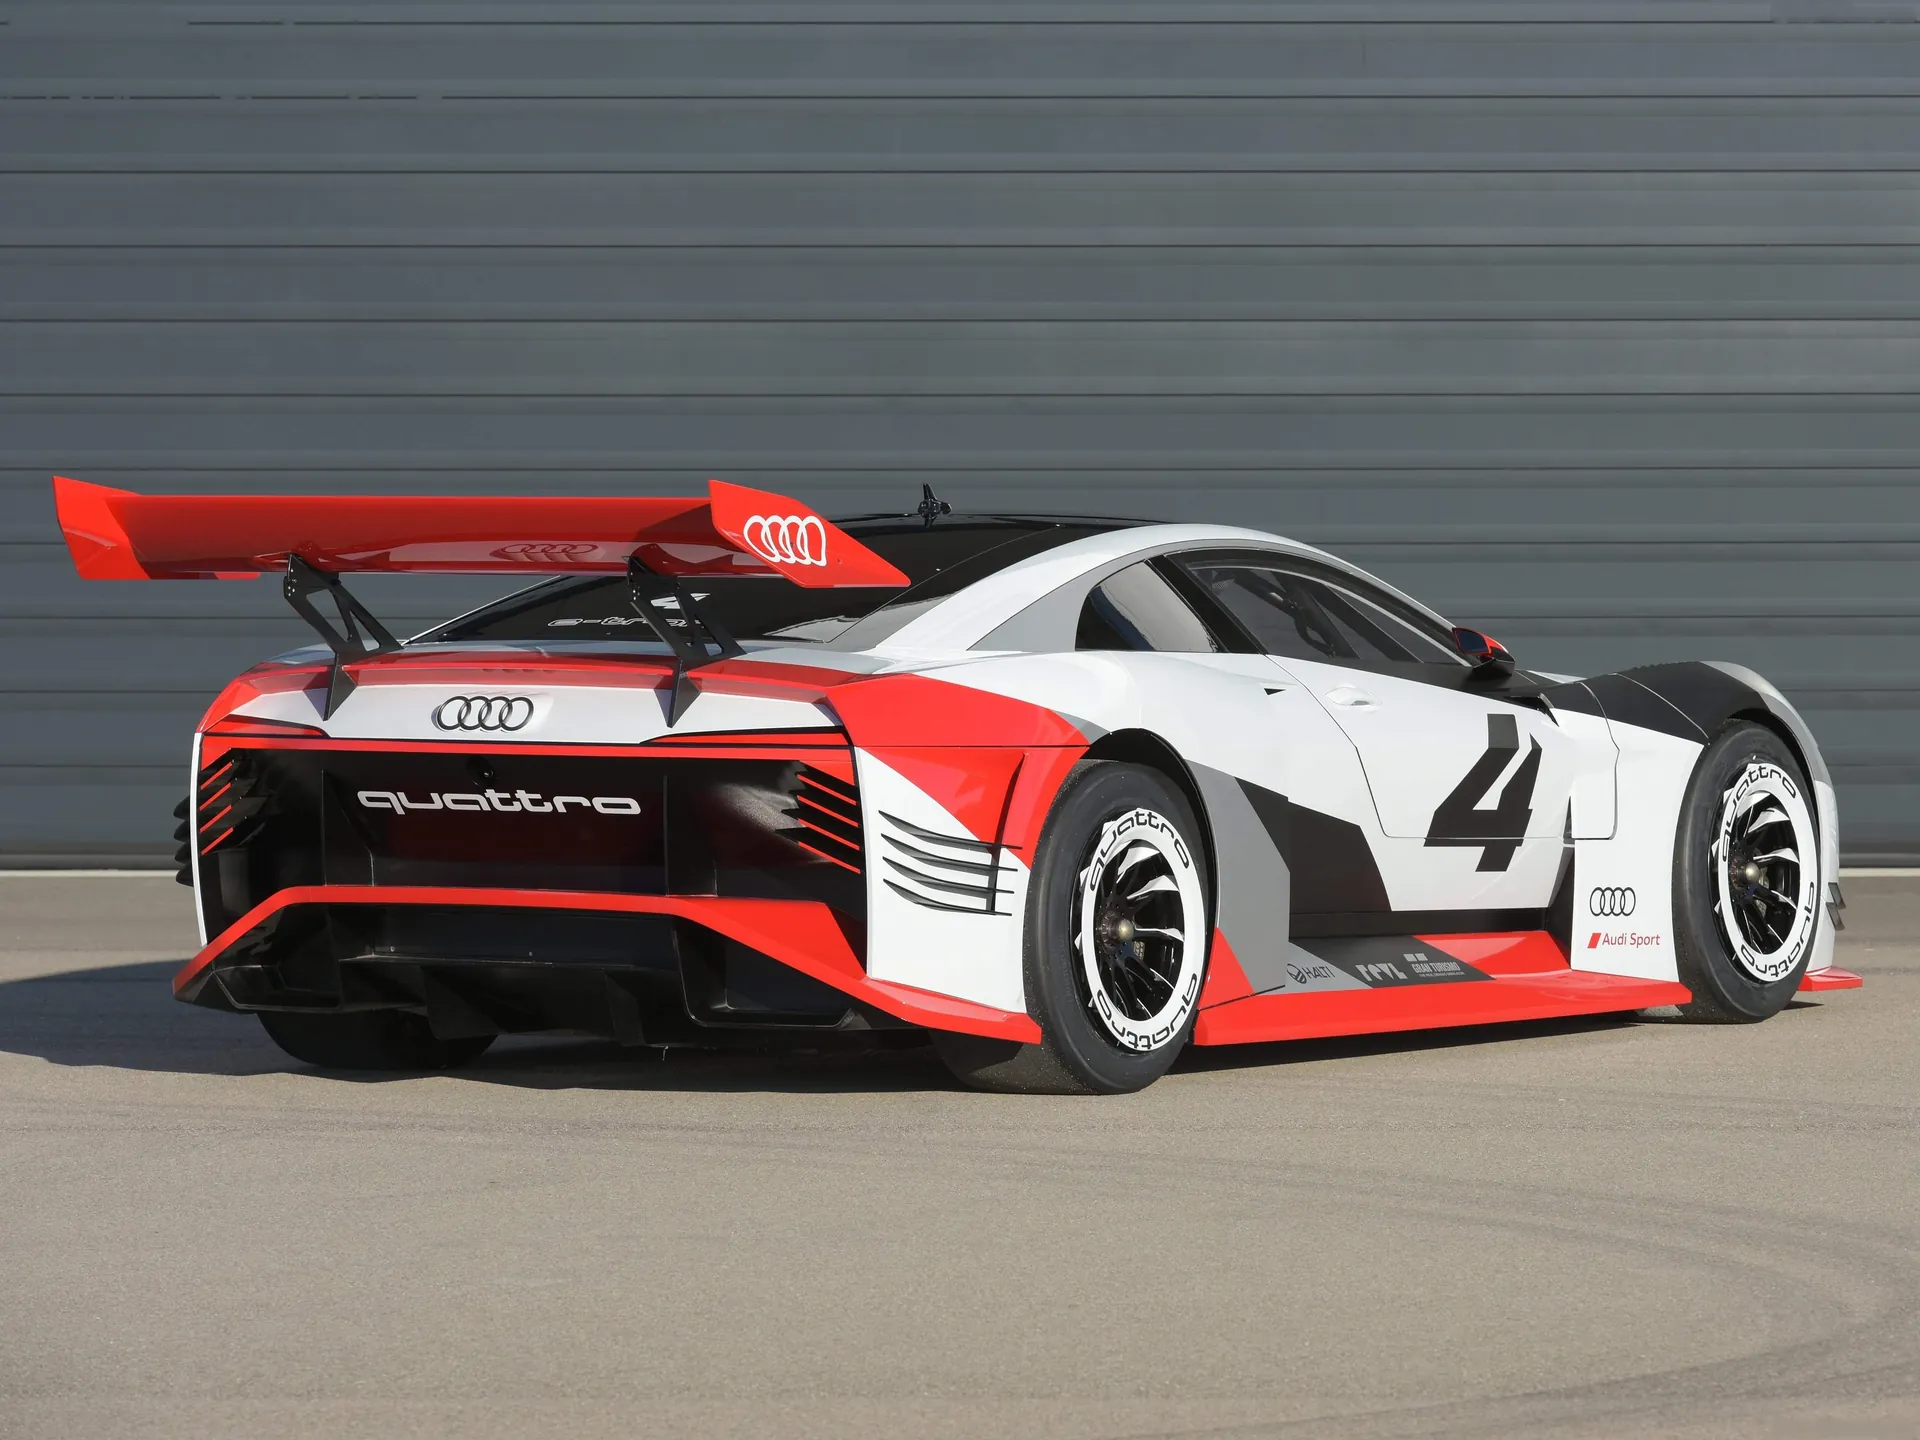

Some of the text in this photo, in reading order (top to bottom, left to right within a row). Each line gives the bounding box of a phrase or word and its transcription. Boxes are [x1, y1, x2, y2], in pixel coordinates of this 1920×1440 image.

[357, 788, 642, 815] quattro
[1423, 713, 1543, 872] 4
[1722, 765, 1796, 863] quattro
[1089, 811, 1190, 892] quattro
[1602, 932, 1661, 949] Audi Sport
[1740, 881, 1814, 979] quattro
[1097, 973, 1198, 1050] quattro
[1301, 965, 1336, 980] HALTI
